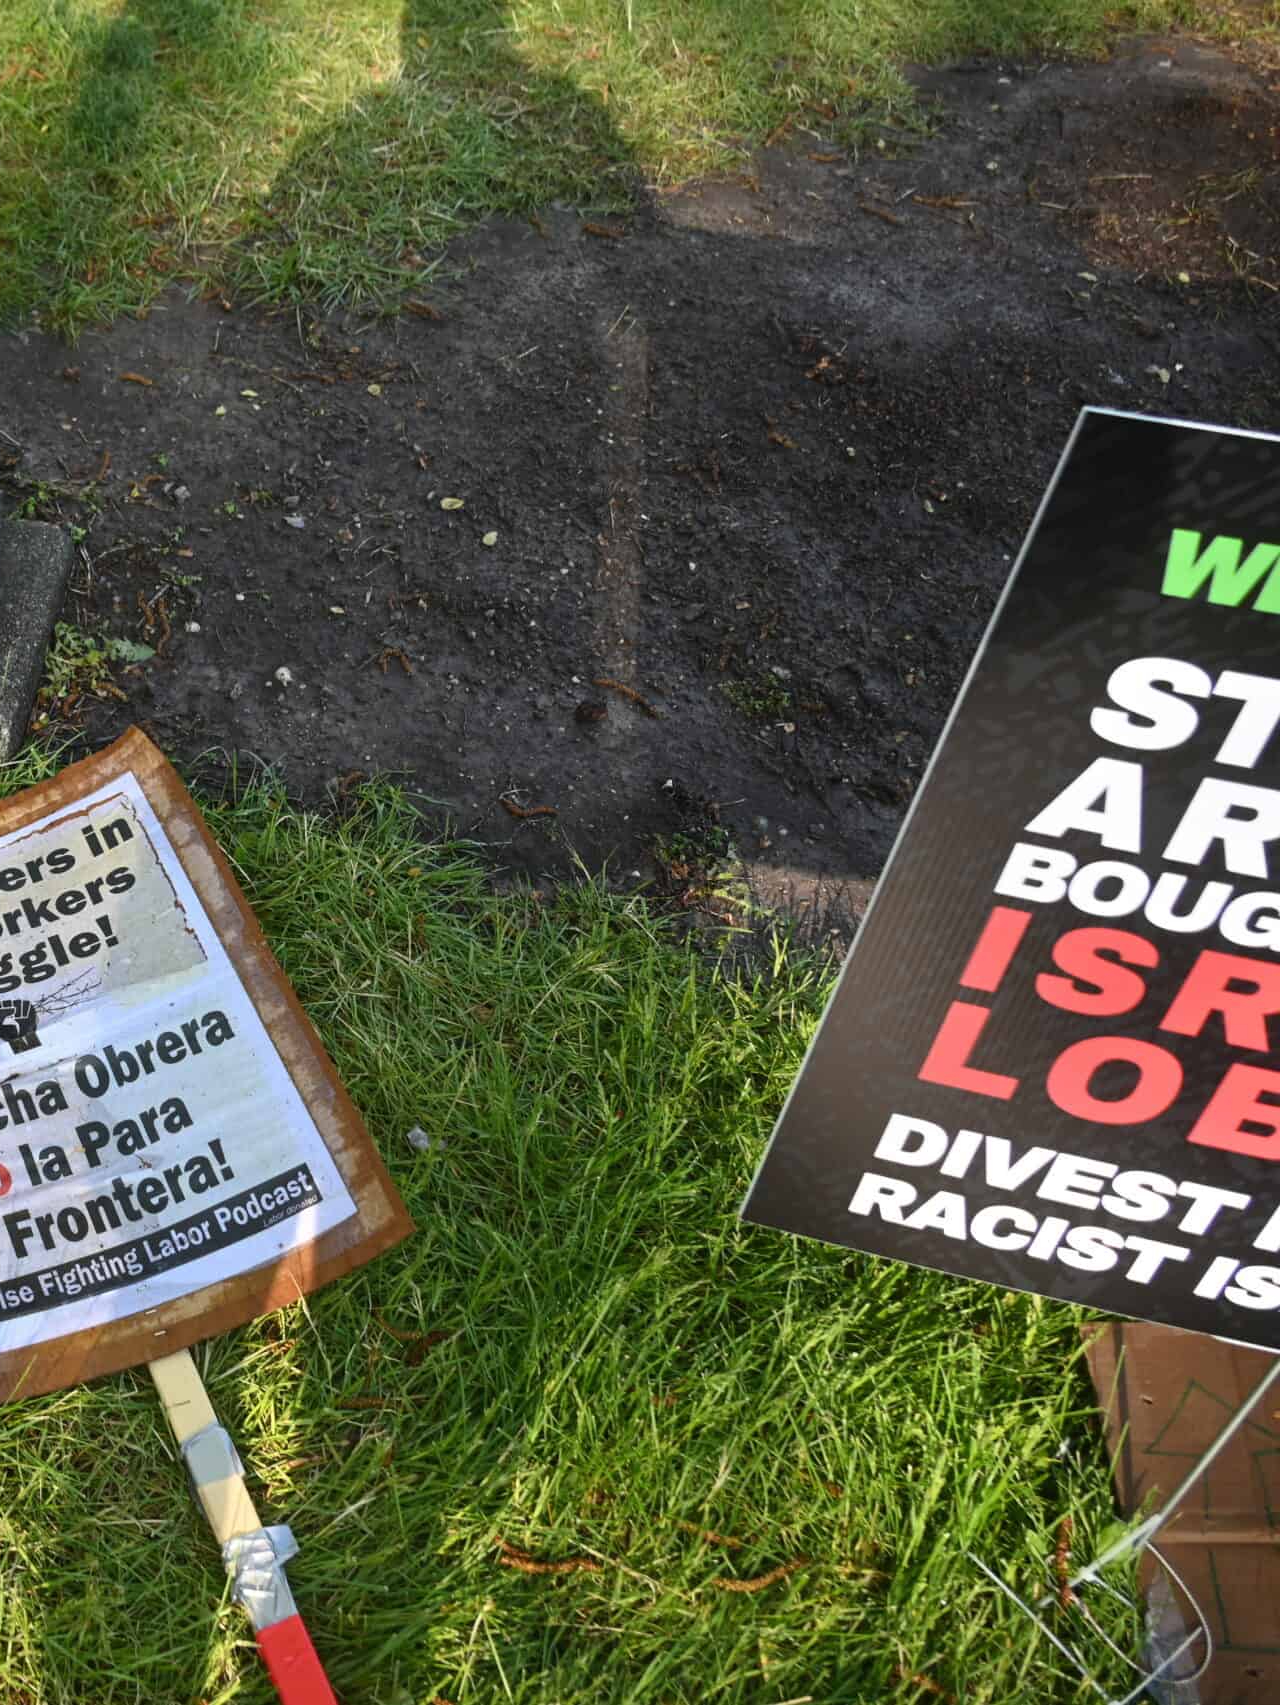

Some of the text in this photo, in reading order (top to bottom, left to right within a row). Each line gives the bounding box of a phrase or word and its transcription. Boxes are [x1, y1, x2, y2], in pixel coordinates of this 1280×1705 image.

[81, 816, 134, 857] in
[992, 843, 1280, 952] BOUG
[959, 906, 1280, 1053] ISR
[75, 1008, 234, 1099] Obrera
[19, 1140, 74, 1187] la
[76, 1097, 194, 1169] Para
[873, 1112, 1252, 1237] DIVEST
[3, 1138, 236, 1259] Frontera!
[38, 1248, 142, 1298] Fighting
[144, 1217, 212, 1264] Labor
[214, 1171, 312, 1232] Podcast
[847, 1172, 1191, 1284] RACIST
